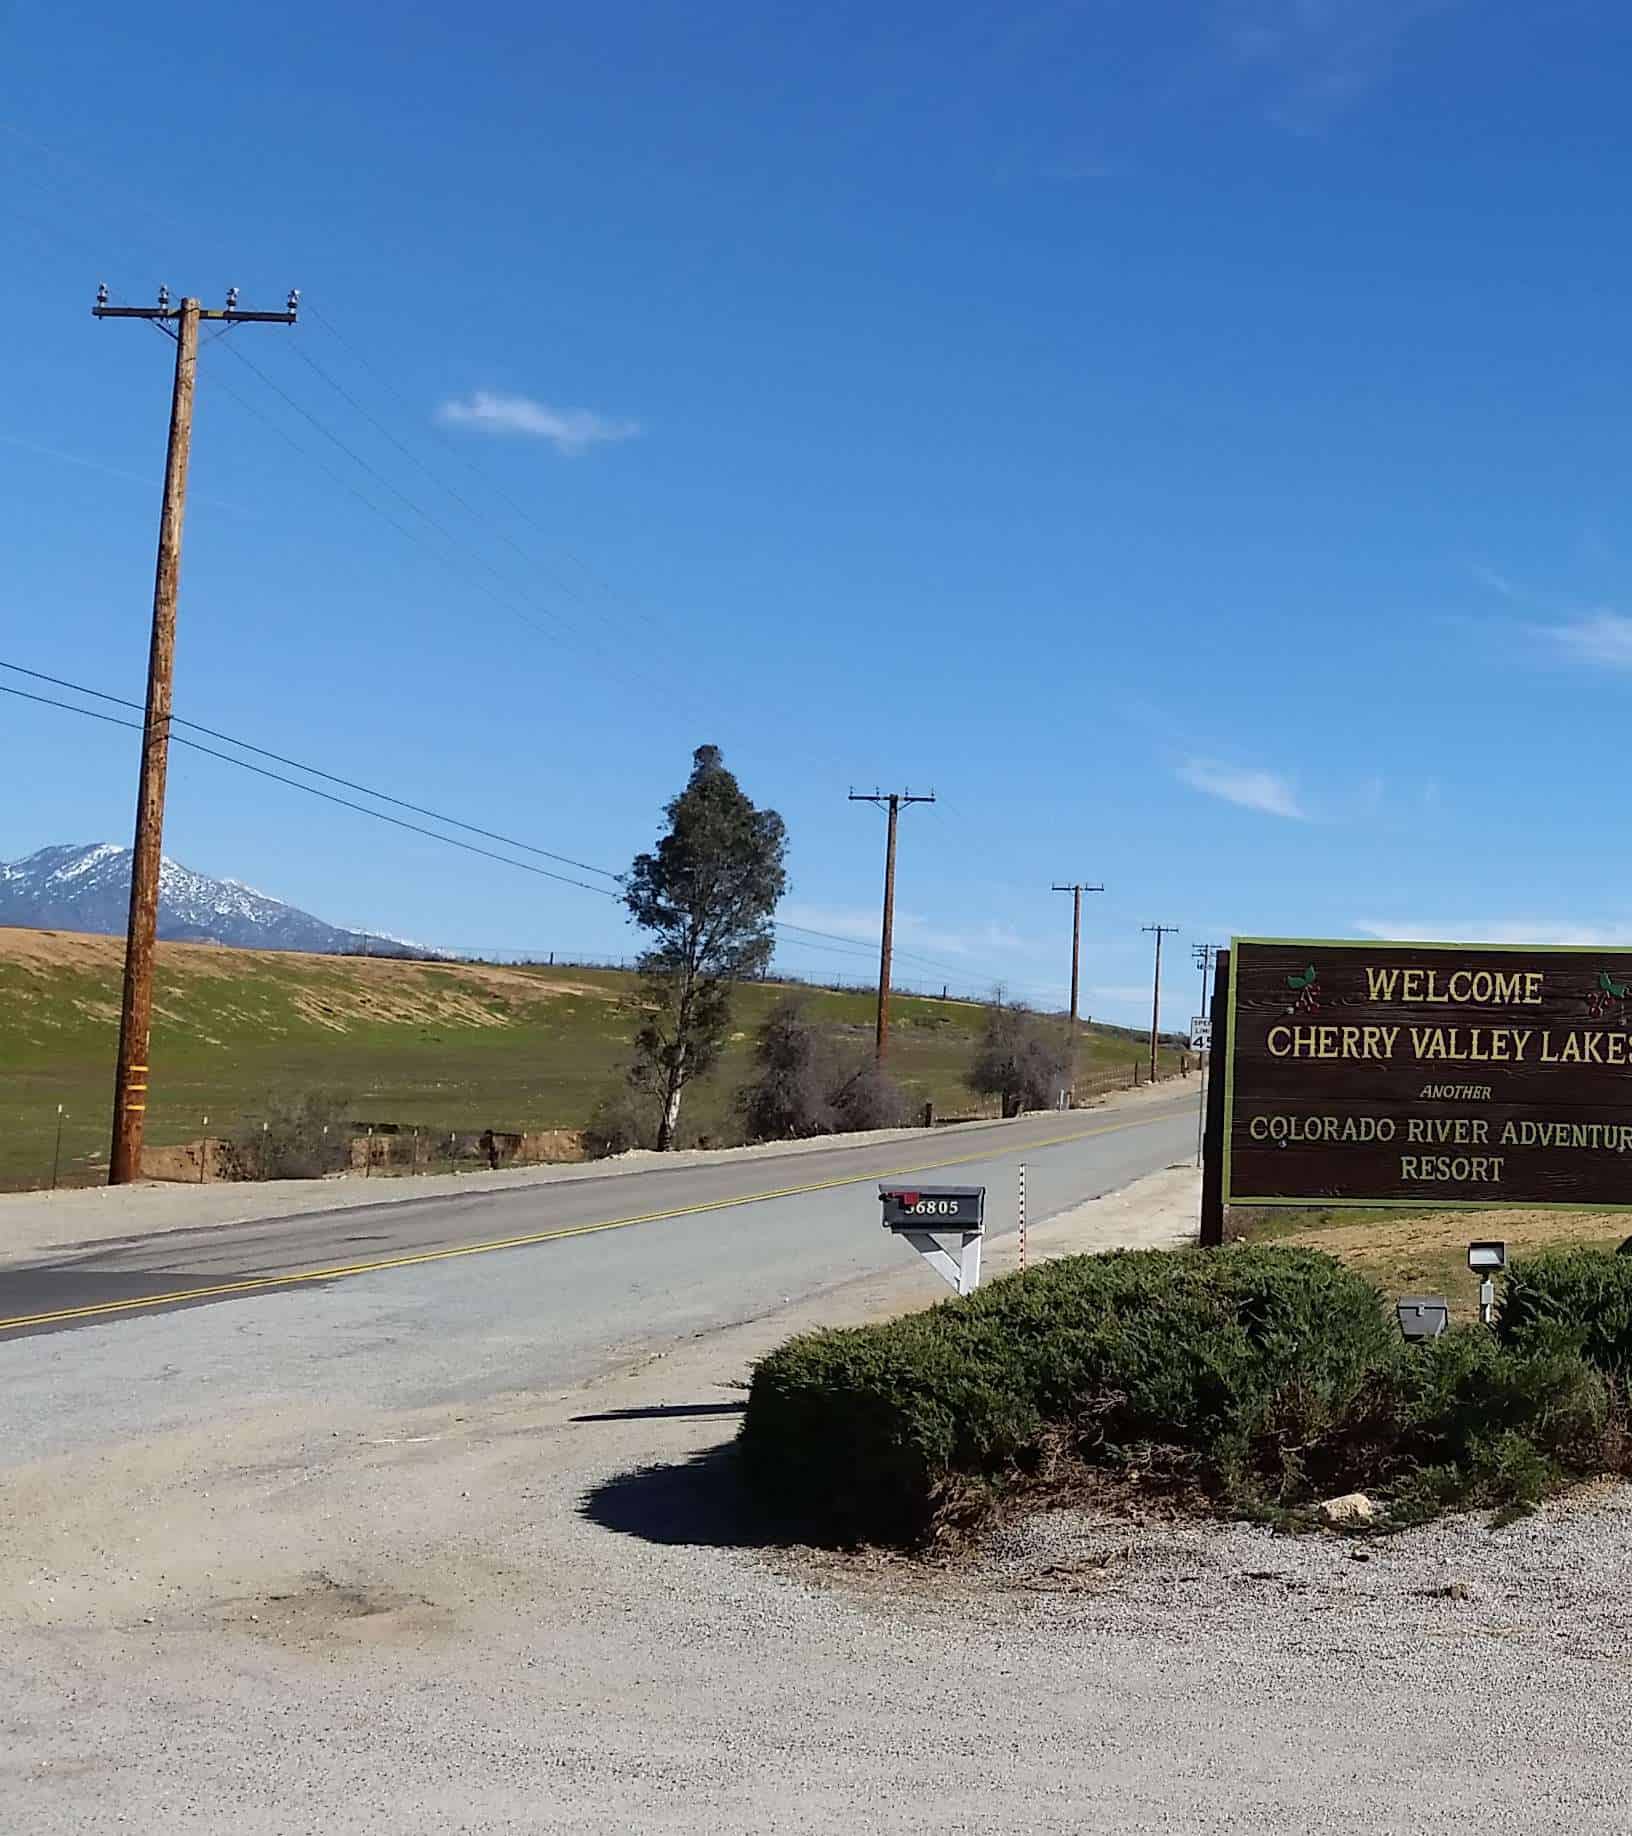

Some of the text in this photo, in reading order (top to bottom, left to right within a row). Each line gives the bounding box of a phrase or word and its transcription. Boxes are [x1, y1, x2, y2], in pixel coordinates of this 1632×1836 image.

[1365, 967, 1544, 1004] WELCOME
[1267, 1025, 1400, 1059] CHERRY
[1409, 1028, 1532, 1061] VALLEY
[1419, 1084, 1492, 1100] ANOTHER
[1250, 1116, 1395, 1142] COLORADO
[1407, 1119, 1489, 1144] RIVER
[1400, 1156, 1504, 1182] RESORT
